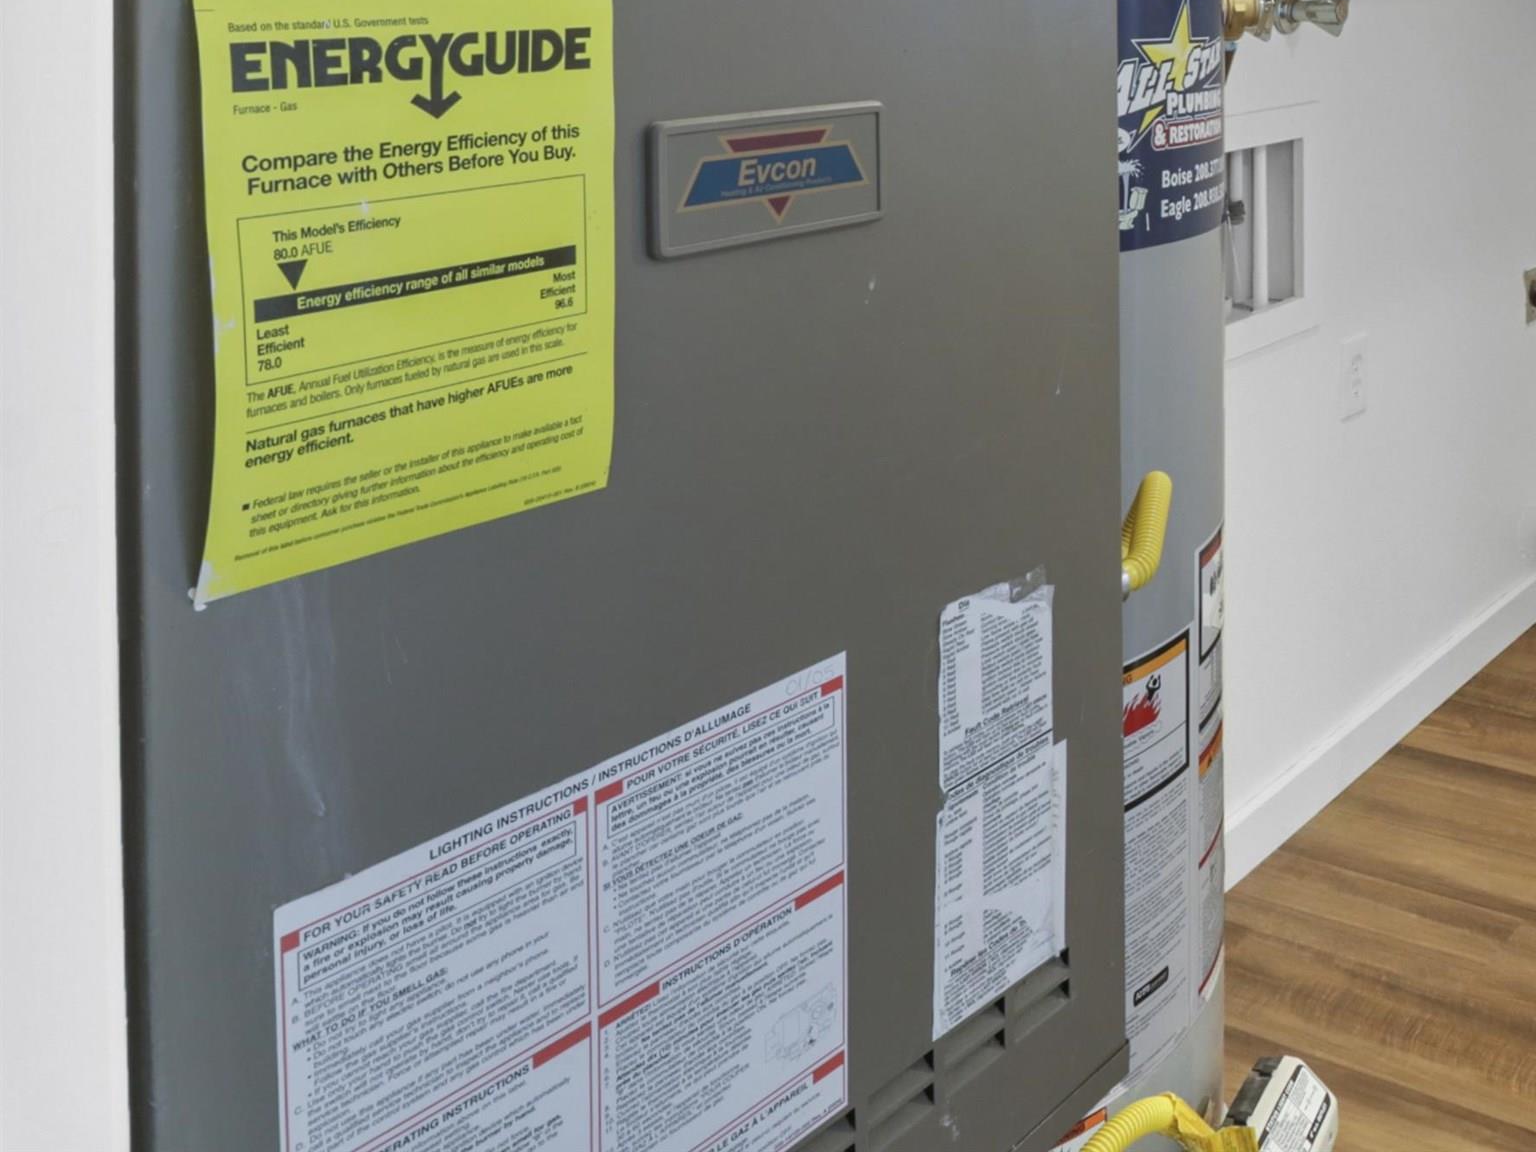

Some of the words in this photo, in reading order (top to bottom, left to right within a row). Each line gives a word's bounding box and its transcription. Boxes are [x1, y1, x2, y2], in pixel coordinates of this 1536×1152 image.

[227, 22, 258, 33] Based
[259, 22, 273, 32] on
[274, 21, 290, 31] the
[332, 18, 351, 29] U.S.
[354, 17, 407, 28] Government
[408, 17, 429, 25] tests
[229, 27, 592, 100] ENERGYGUIDE
[233, 104, 271, 115] Furnace
[279, 101, 298, 112] Gas
[242, 152, 337, 173] Compare
[343, 146, 373, 163] the
[379, 141, 442, 159] Energy
[447, 132, 527, 151] Efficiency
[531, 126, 548, 143] of
[551, 124, 580, 140] this
[1155, 122, 1167, 147] &
[247, 174, 332, 195] Furnace
[338, 166, 377, 184] with
[383, 161, 443, 179] Others
[448, 154, 504, 172] Before
[508, 148, 539, 164] You
[543, 145, 576, 161] Buy.
[736, 155, 817, 188] Evcon
[1161, 168, 1193, 190] Boise
[1160, 197, 1192, 221] Eagle
[272, 230, 298, 242] This
[300, 223, 345, 238] Model's
[348, 217, 401, 232] Efficiency
[273, 246, 299, 261] 80.0
[301, 240, 333, 256] AFUE
[297, 293, 342, 310] Energy
[345, 283, 403, 301] efficiency
[405, 276, 439, 290] range
[441, 270, 453, 284] of
[455, 268, 469, 282] all
[470, 263, 506, 279] similar
[507, 256, 545, 271] models
[540, 284, 576, 299] Efficient
[553, 271, 576, 283] Most
[256, 324, 289, 341] Least
[257, 337, 305, 356] Efficient
[247, 391, 265, 403] The
[298, 376, 331, 392] Annual
[332, 371, 352, 384] Fuel
[353, 364, 395, 380] Utilization
[446, 349, 460, 359] the
[461, 341, 495, 355] measure
[495, 337, 505, 348] of
[505, 333, 531, 346] energy
[532, 326, 565, 339] efficiency
[566, 322, 578, 332] for
[258, 356, 283, 372] 78.0
[246, 430, 297, 452] Natural
[300, 425, 325, 442] gas
[328, 411, 386, 432] furnaces
[389, 403, 414, 418] that
[416, 397, 445, 411] have
[448, 387, 484, 404] higher
[487, 376, 524, 394] AFUEs
[526, 372, 544, 385] are
[546, 365, 573, 379] more
[245, 449, 294, 468] energy
[297, 433, 353, 455] efficient.
[626, 769, 656, 789] POUR
[658, 752, 690, 774] VOTRE
[742, 715, 767, 734] LISEZ
[769, 709, 781, 721] CE
[800, 691, 818, 707] SUIT
[429, 823, 493, 860] LIGHTING
[497, 779, 589, 828] INSTRUCTIONS
[598, 736, 680, 781] INSTRUCTIONS
[678, 703, 750, 744] D'ALLUMAGE
[303, 922, 331, 942] FOR
[335, 903, 371, 926] YOUR
[375, 879, 421, 909] SAFETY
[425, 863, 458, 885] READ
[461, 840, 506, 868] BEFORE
[510, 809, 571, 845] OPERATING
[662, 943, 731, 990] INSTRUCTIONS
[441, 1064, 531, 1123] INSTRUCTIONS
